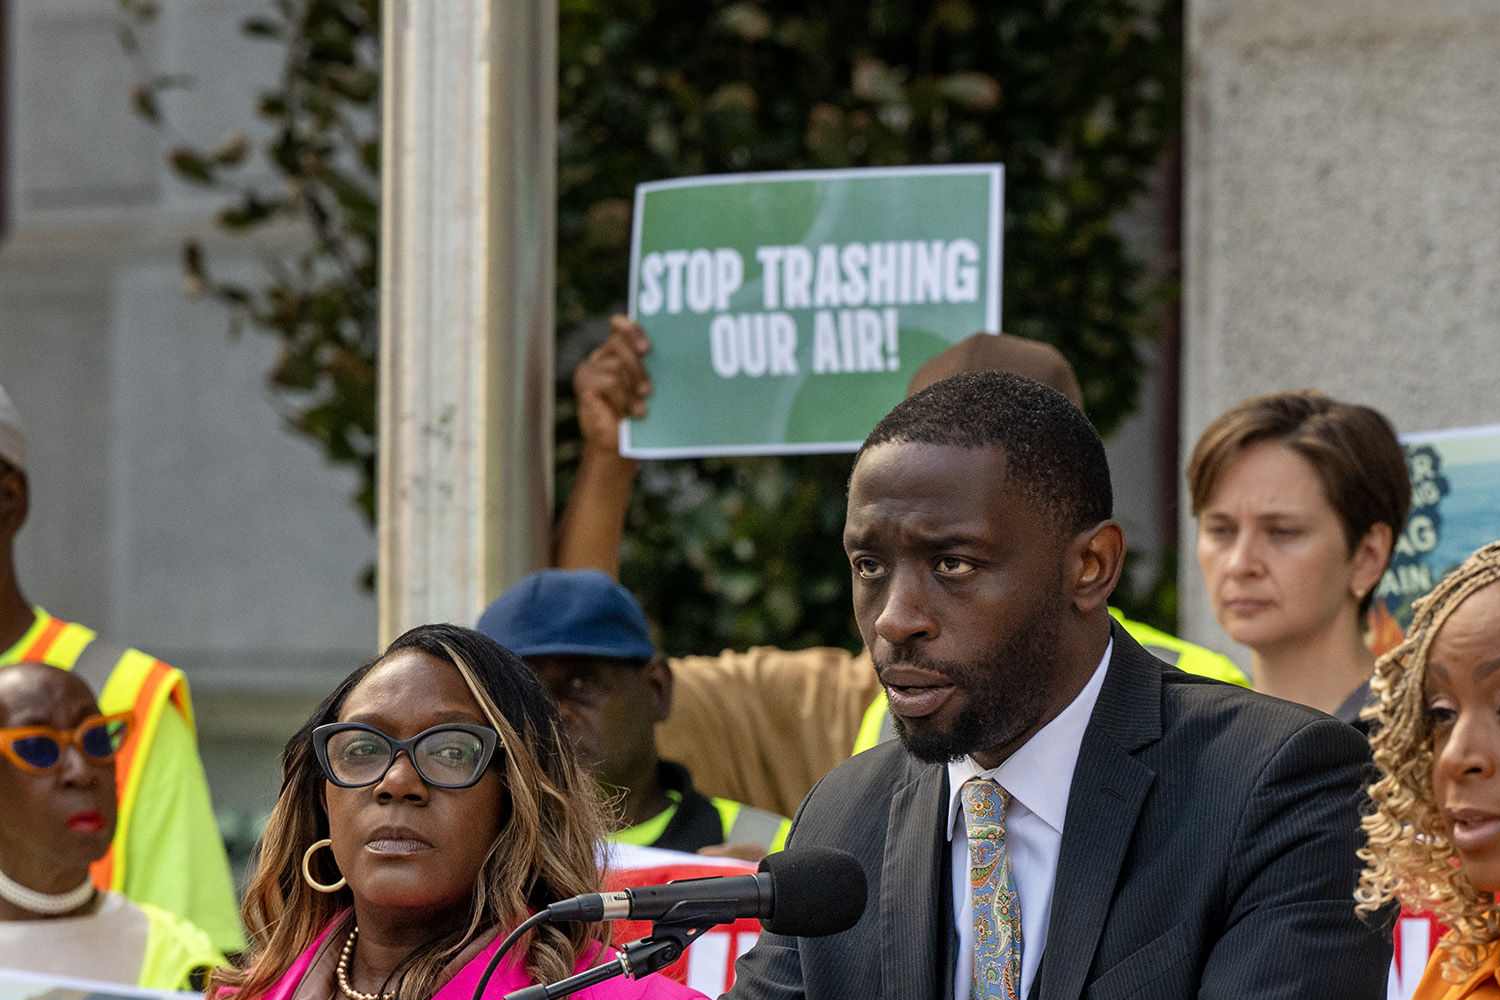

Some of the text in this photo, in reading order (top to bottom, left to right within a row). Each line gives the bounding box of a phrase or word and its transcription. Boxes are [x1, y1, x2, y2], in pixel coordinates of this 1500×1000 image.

[639, 238, 980, 315] STOP TRASHING
[710, 308, 901, 378] OUR AIR!
